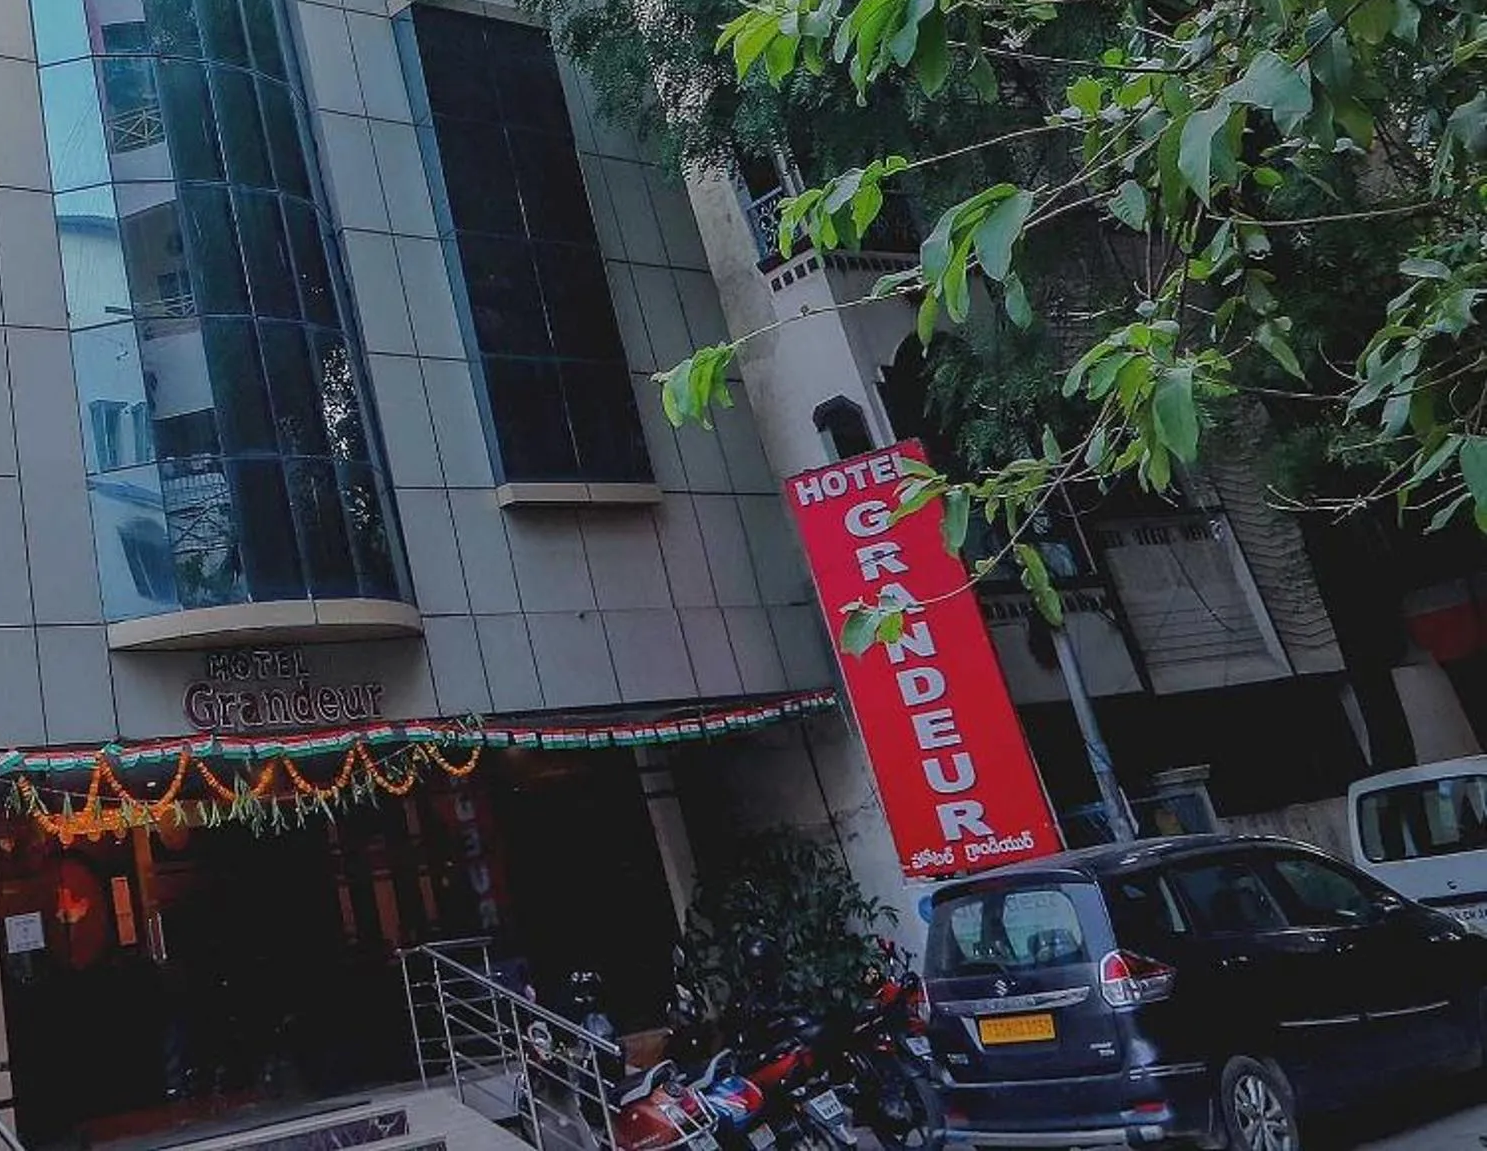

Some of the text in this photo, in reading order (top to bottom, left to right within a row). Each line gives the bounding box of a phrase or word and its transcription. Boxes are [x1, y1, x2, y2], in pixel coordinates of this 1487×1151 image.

[208, 650, 310, 681] HOTEL
[844, 500, 994, 841] GRANDEUR
[183, 679, 386, 730] Grandeur
